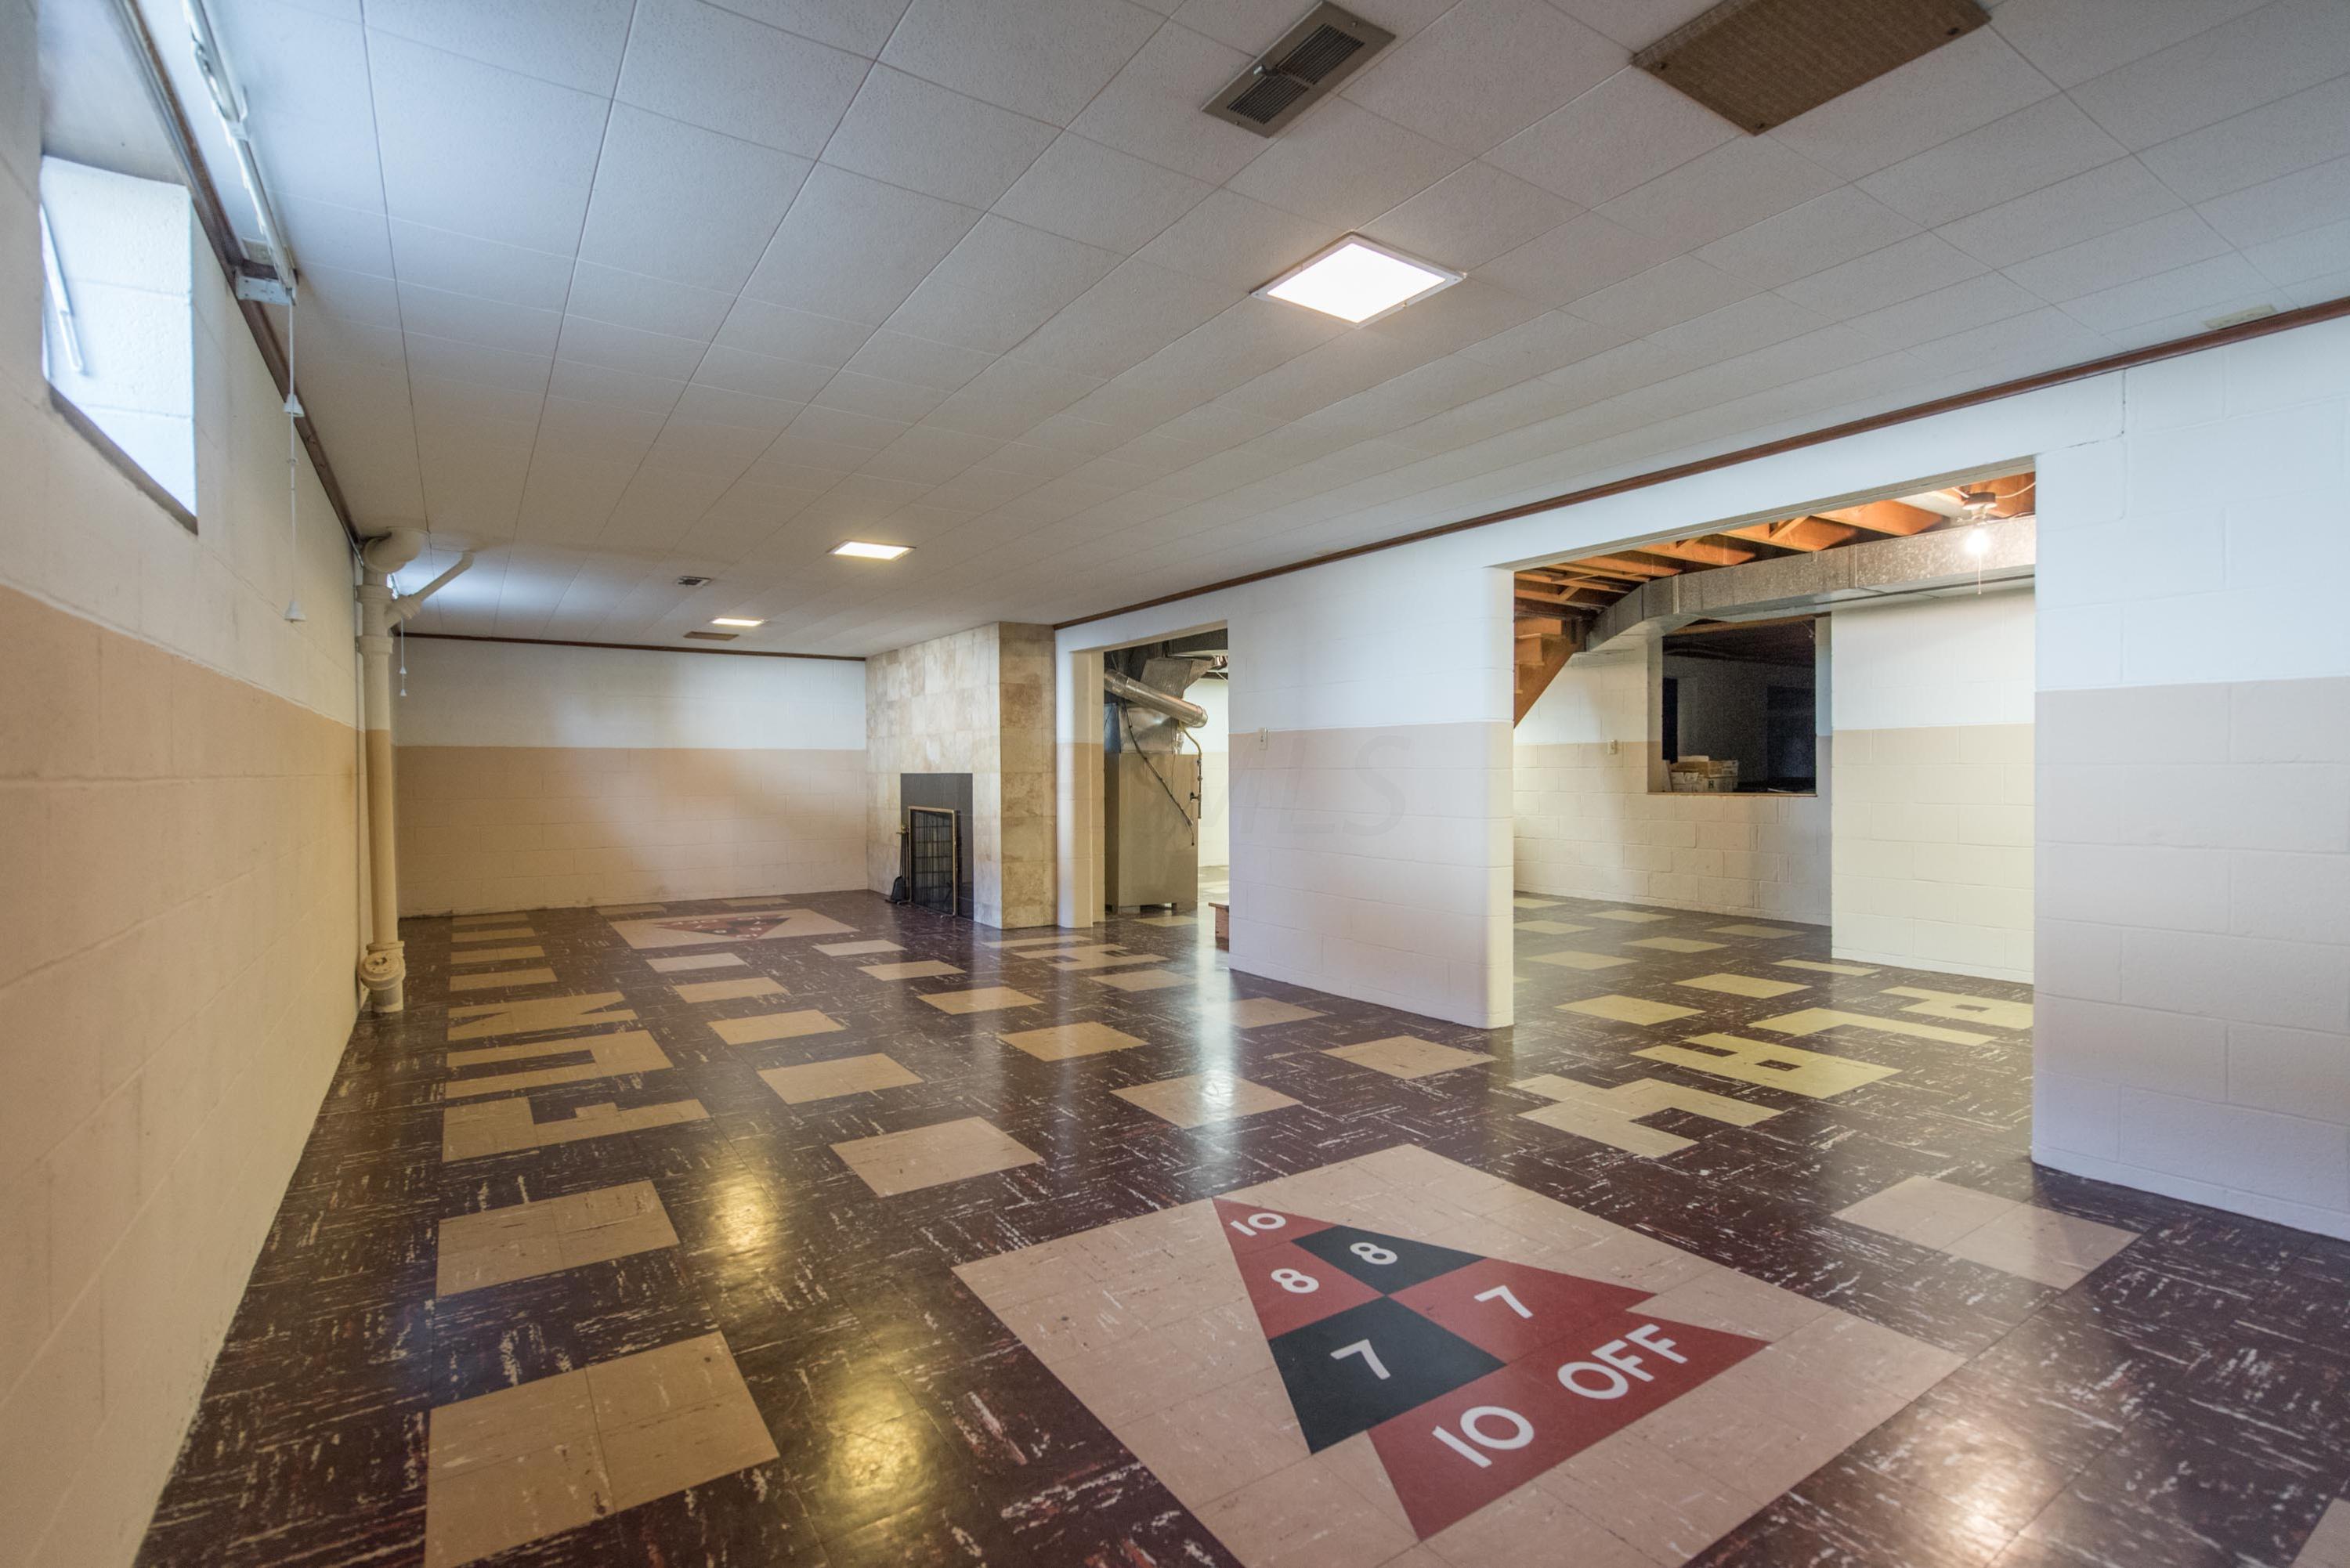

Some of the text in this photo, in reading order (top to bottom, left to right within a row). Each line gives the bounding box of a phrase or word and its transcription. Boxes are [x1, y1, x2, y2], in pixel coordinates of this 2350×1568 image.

[443, 991, 710, 1162] FUN
[1230, 1212, 1286, 1236] 10
[1350, 1242, 1397, 1265] 8
[1271, 1268, 1319, 1293] 8
[1474, 1285, 1533, 1319] 7
[1330, 1339, 1390, 1380] 7
[1432, 1324, 1688, 1467] 10 OFF
